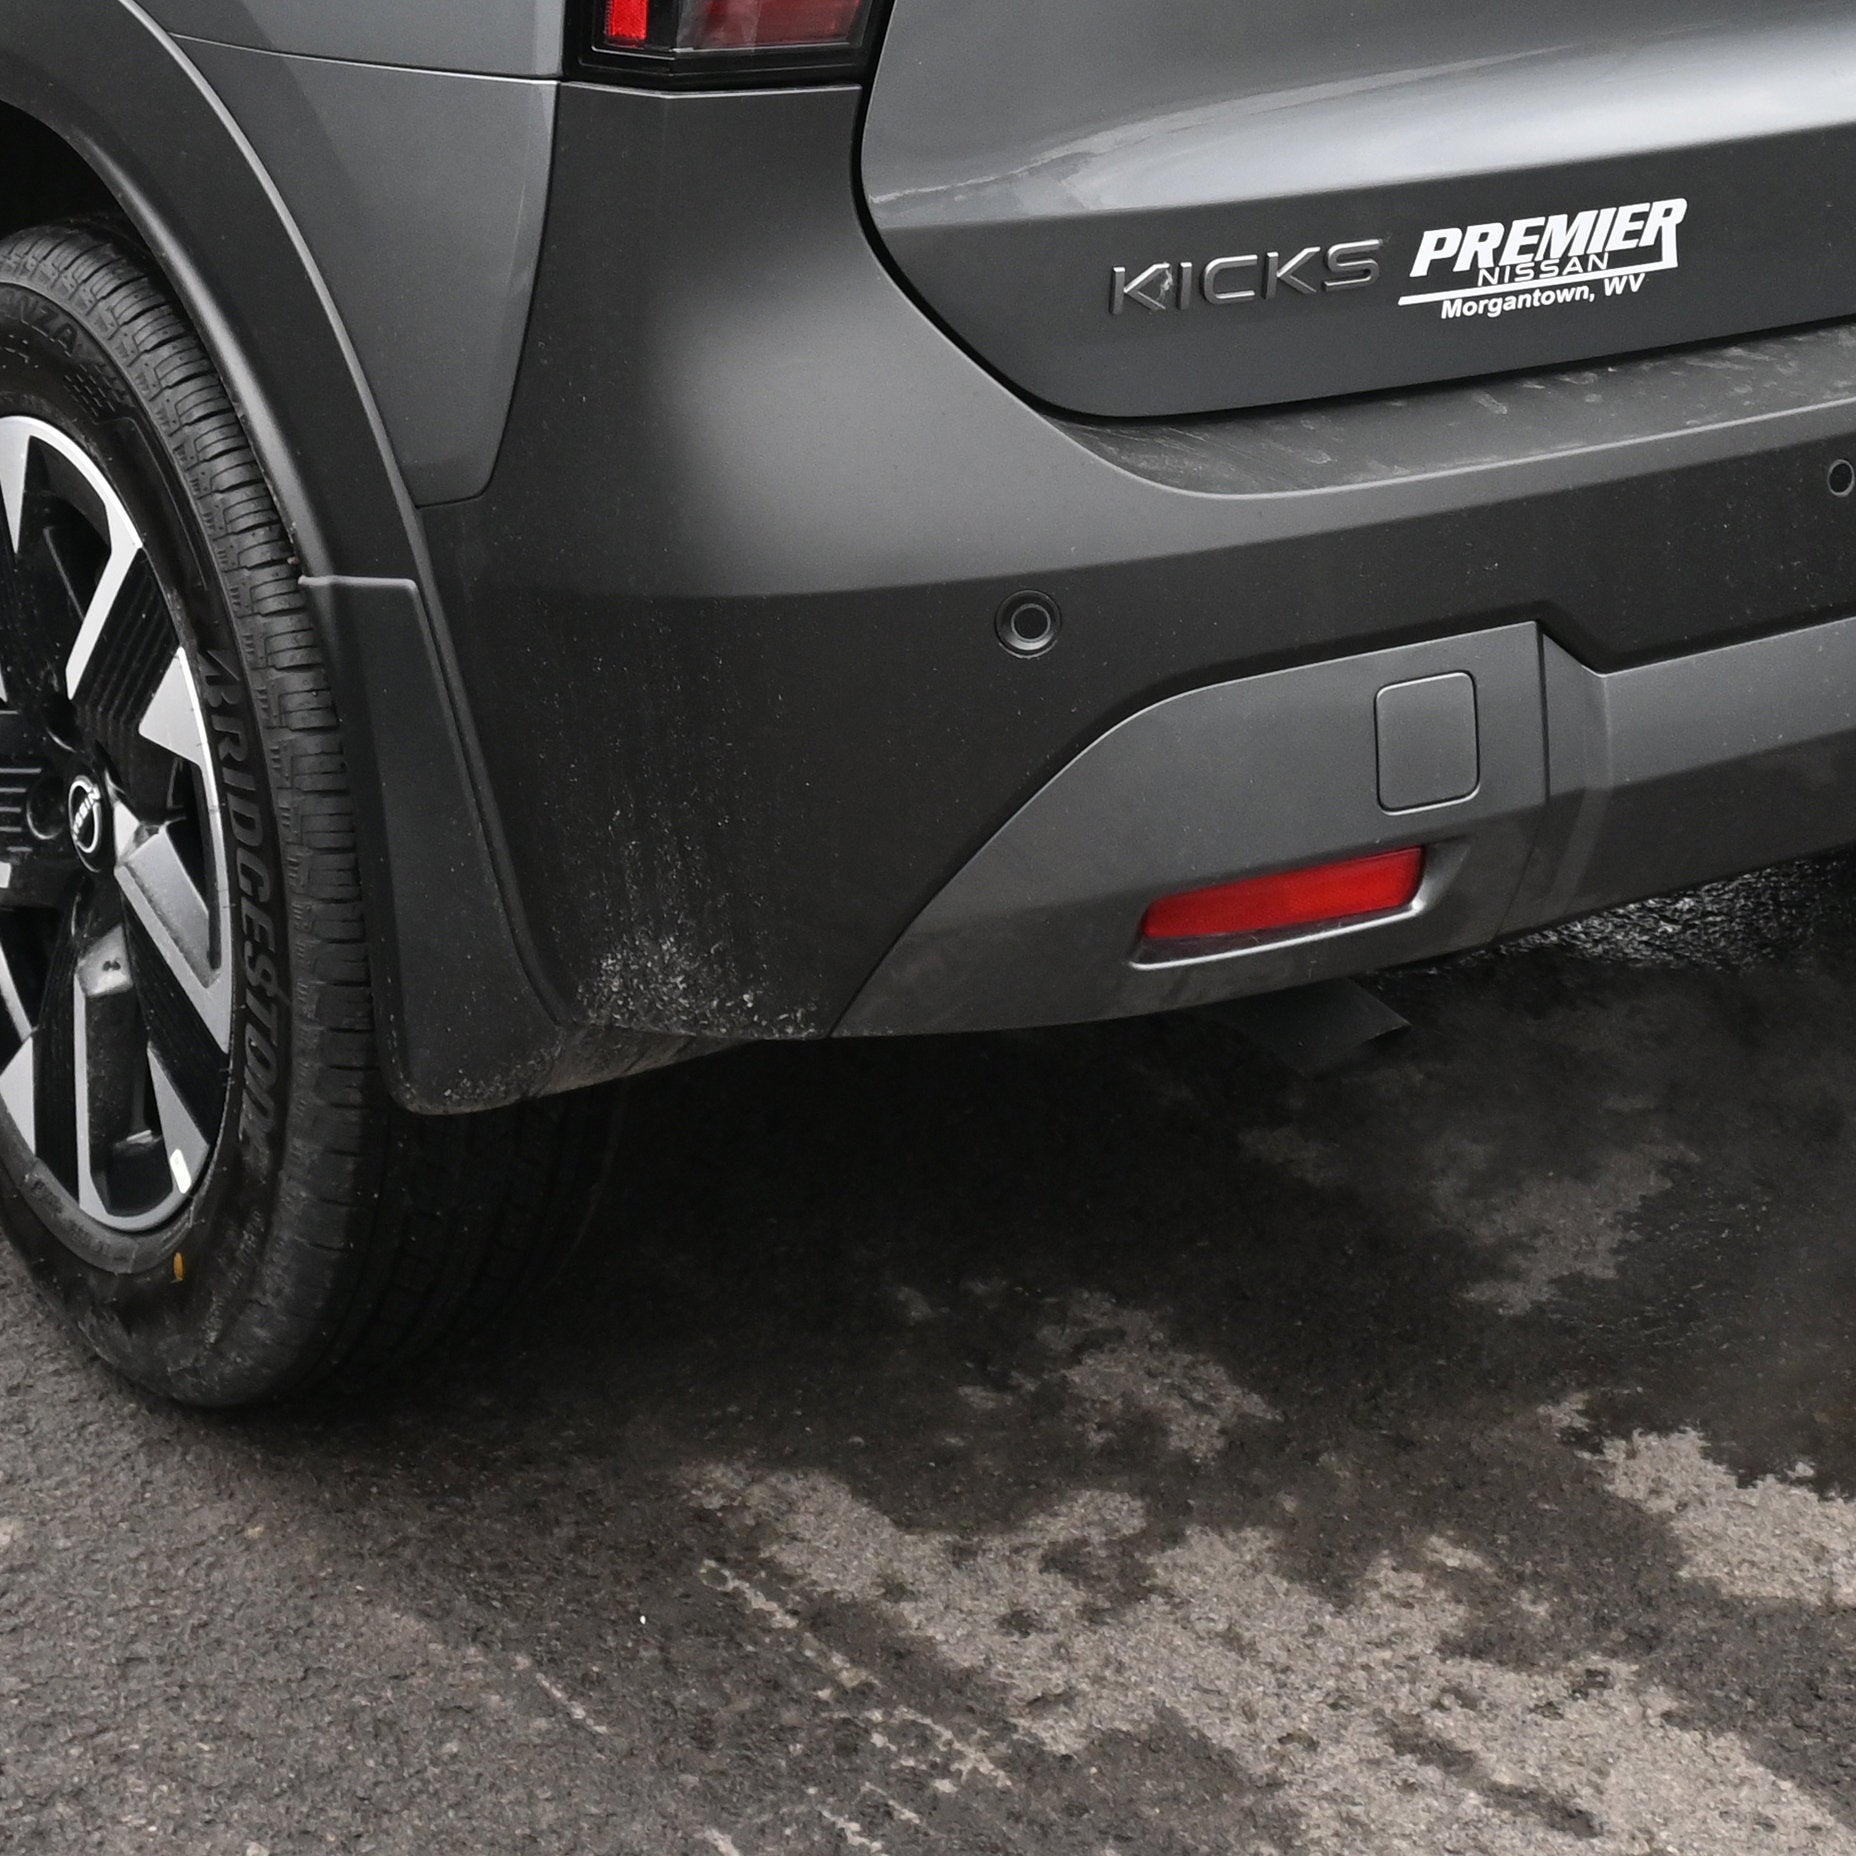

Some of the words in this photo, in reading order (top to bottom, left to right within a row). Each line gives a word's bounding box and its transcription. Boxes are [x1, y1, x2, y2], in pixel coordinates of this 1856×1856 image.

[1409, 197, 1687, 278] PREMIER
[1109, 238, 1382, 315] KICKS
[1440, 285, 1596, 320] Morgantown,
[1602, 272, 1646, 295] WV
[1477, 251, 1610, 287] NISSAN
